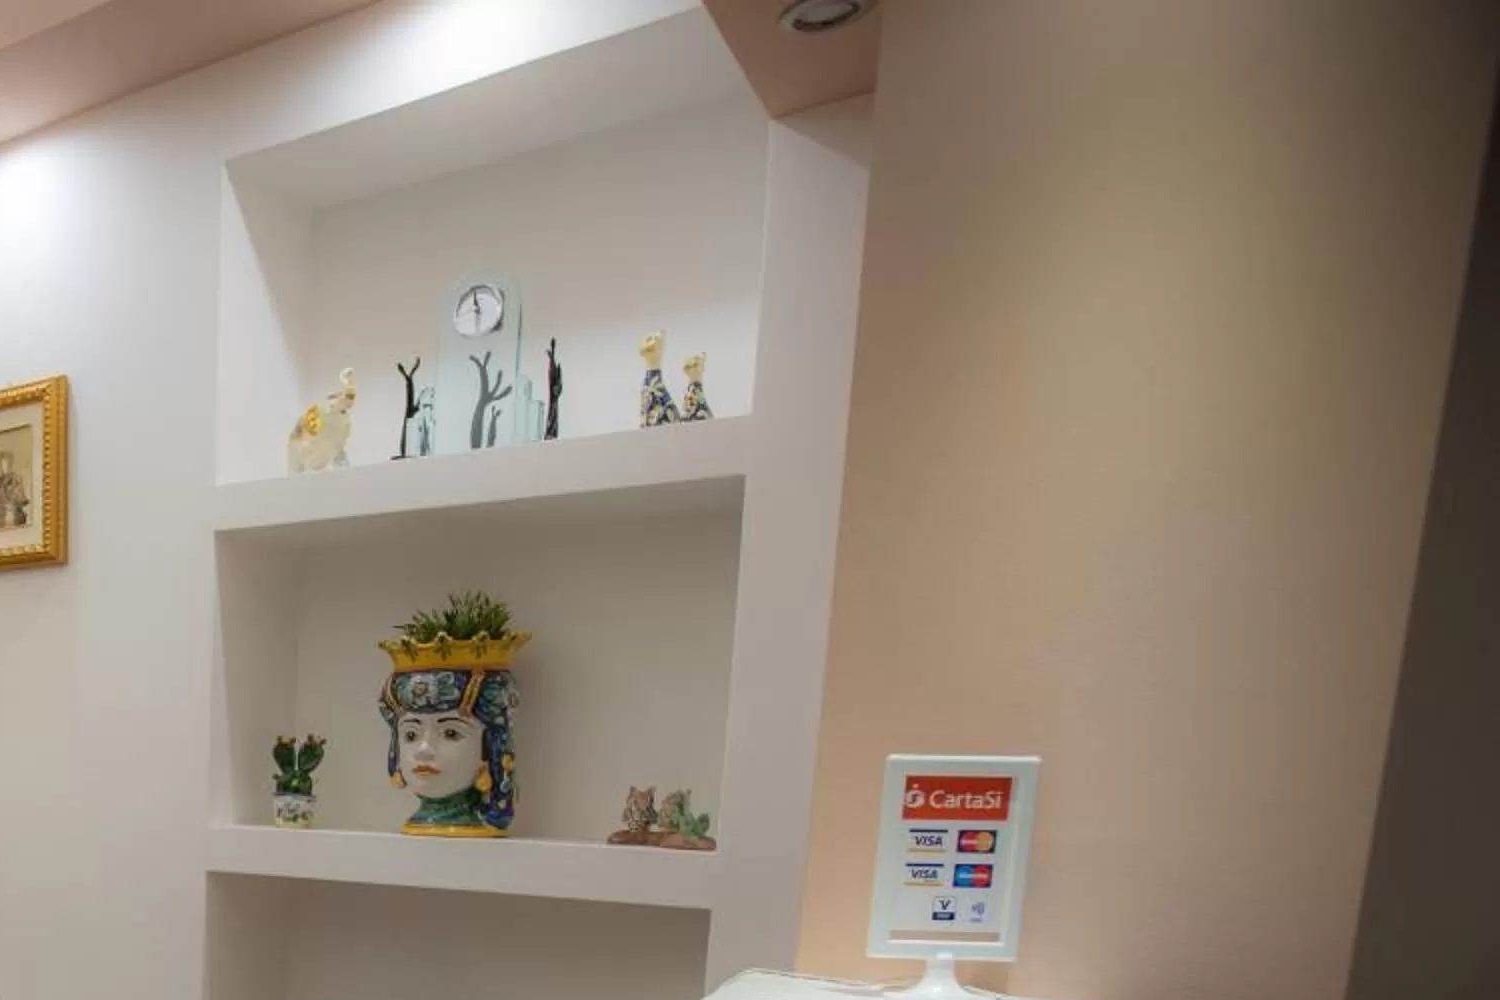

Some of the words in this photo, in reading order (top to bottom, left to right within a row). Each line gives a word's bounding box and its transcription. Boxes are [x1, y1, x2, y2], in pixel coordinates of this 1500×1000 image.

[929, 789, 1004, 809] CartaSi
[915, 835, 943, 846] VISA
[911, 868, 938, 879] VISA
